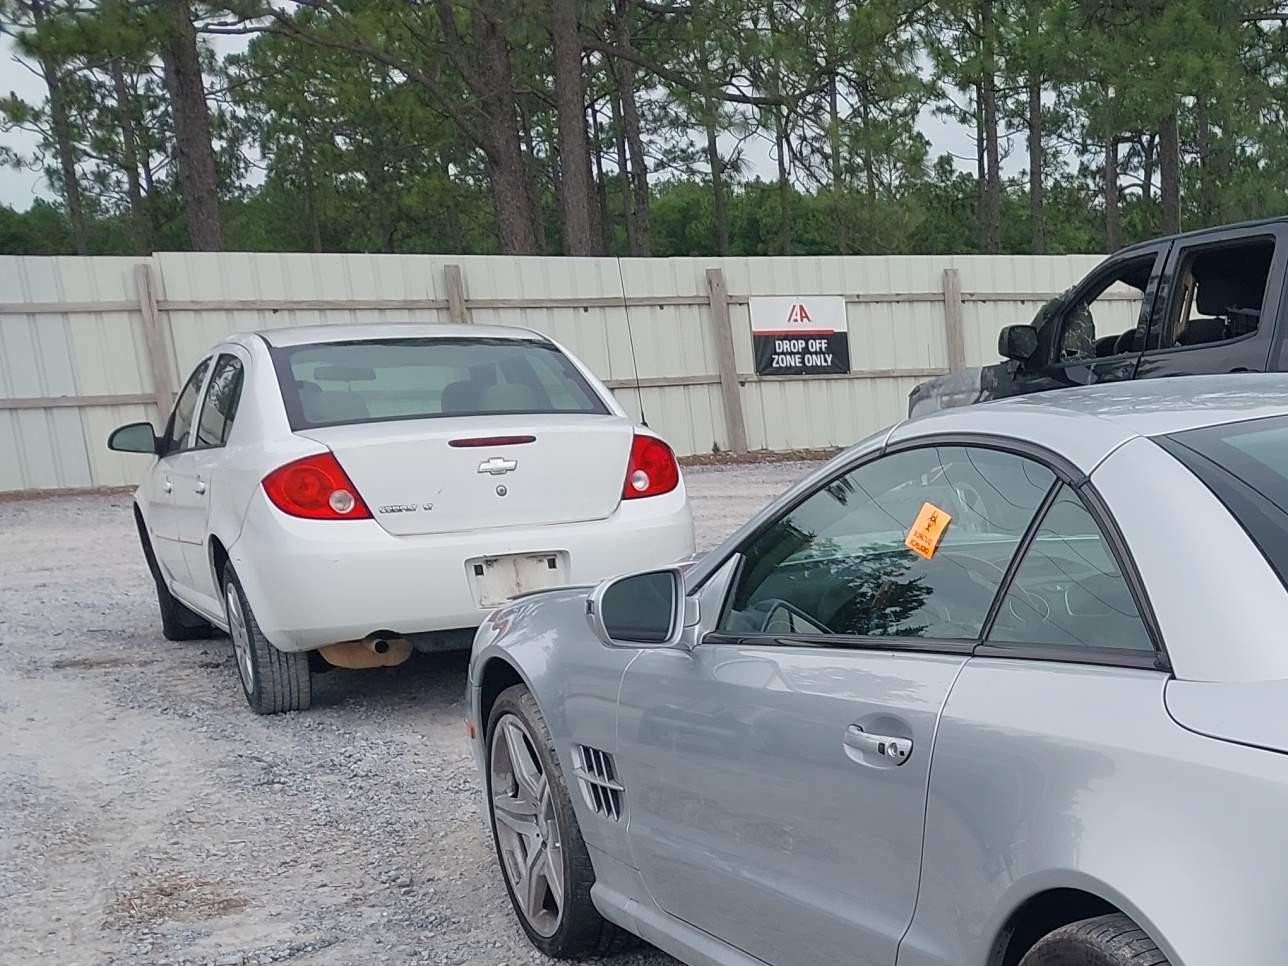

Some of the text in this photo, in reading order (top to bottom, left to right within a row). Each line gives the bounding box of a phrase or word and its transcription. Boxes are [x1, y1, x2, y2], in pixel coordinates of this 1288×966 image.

[775, 339, 828, 353] DROP OFF
[772, 353, 833, 368] ZONE ONLY
